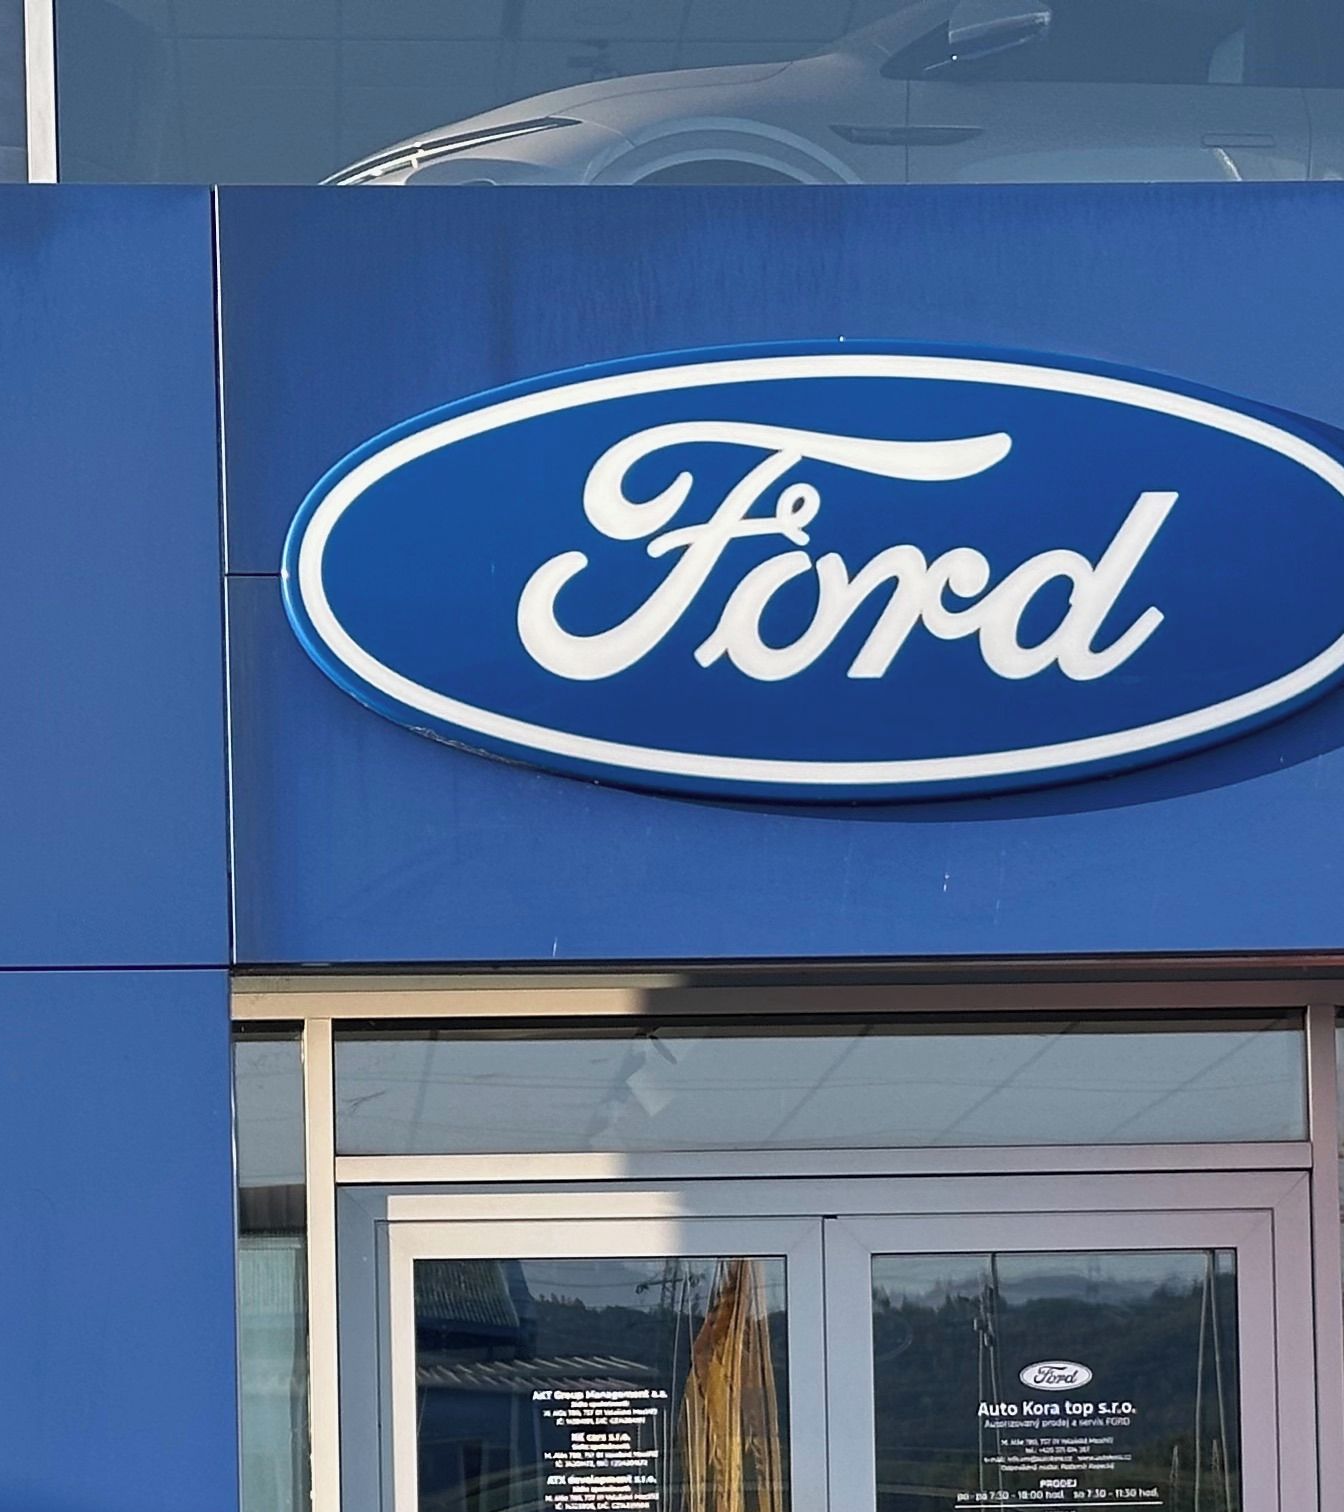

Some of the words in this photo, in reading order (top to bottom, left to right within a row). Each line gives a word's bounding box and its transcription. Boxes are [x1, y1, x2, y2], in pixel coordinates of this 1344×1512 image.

[517, 420, 1179, 681] Ford
[978, 1401, 1018, 1416] Auto
[1023, 1401, 1060, 1415] Kora
[1065, 1400, 1094, 1416] top
[1098, 1401, 1137, 1415] s.r.o.
[1042, 1418, 1070, 1428] prodej
[1106, 1417, 1130, 1426] FORD
[1040, 1479, 1077, 1488] PRODEJ
